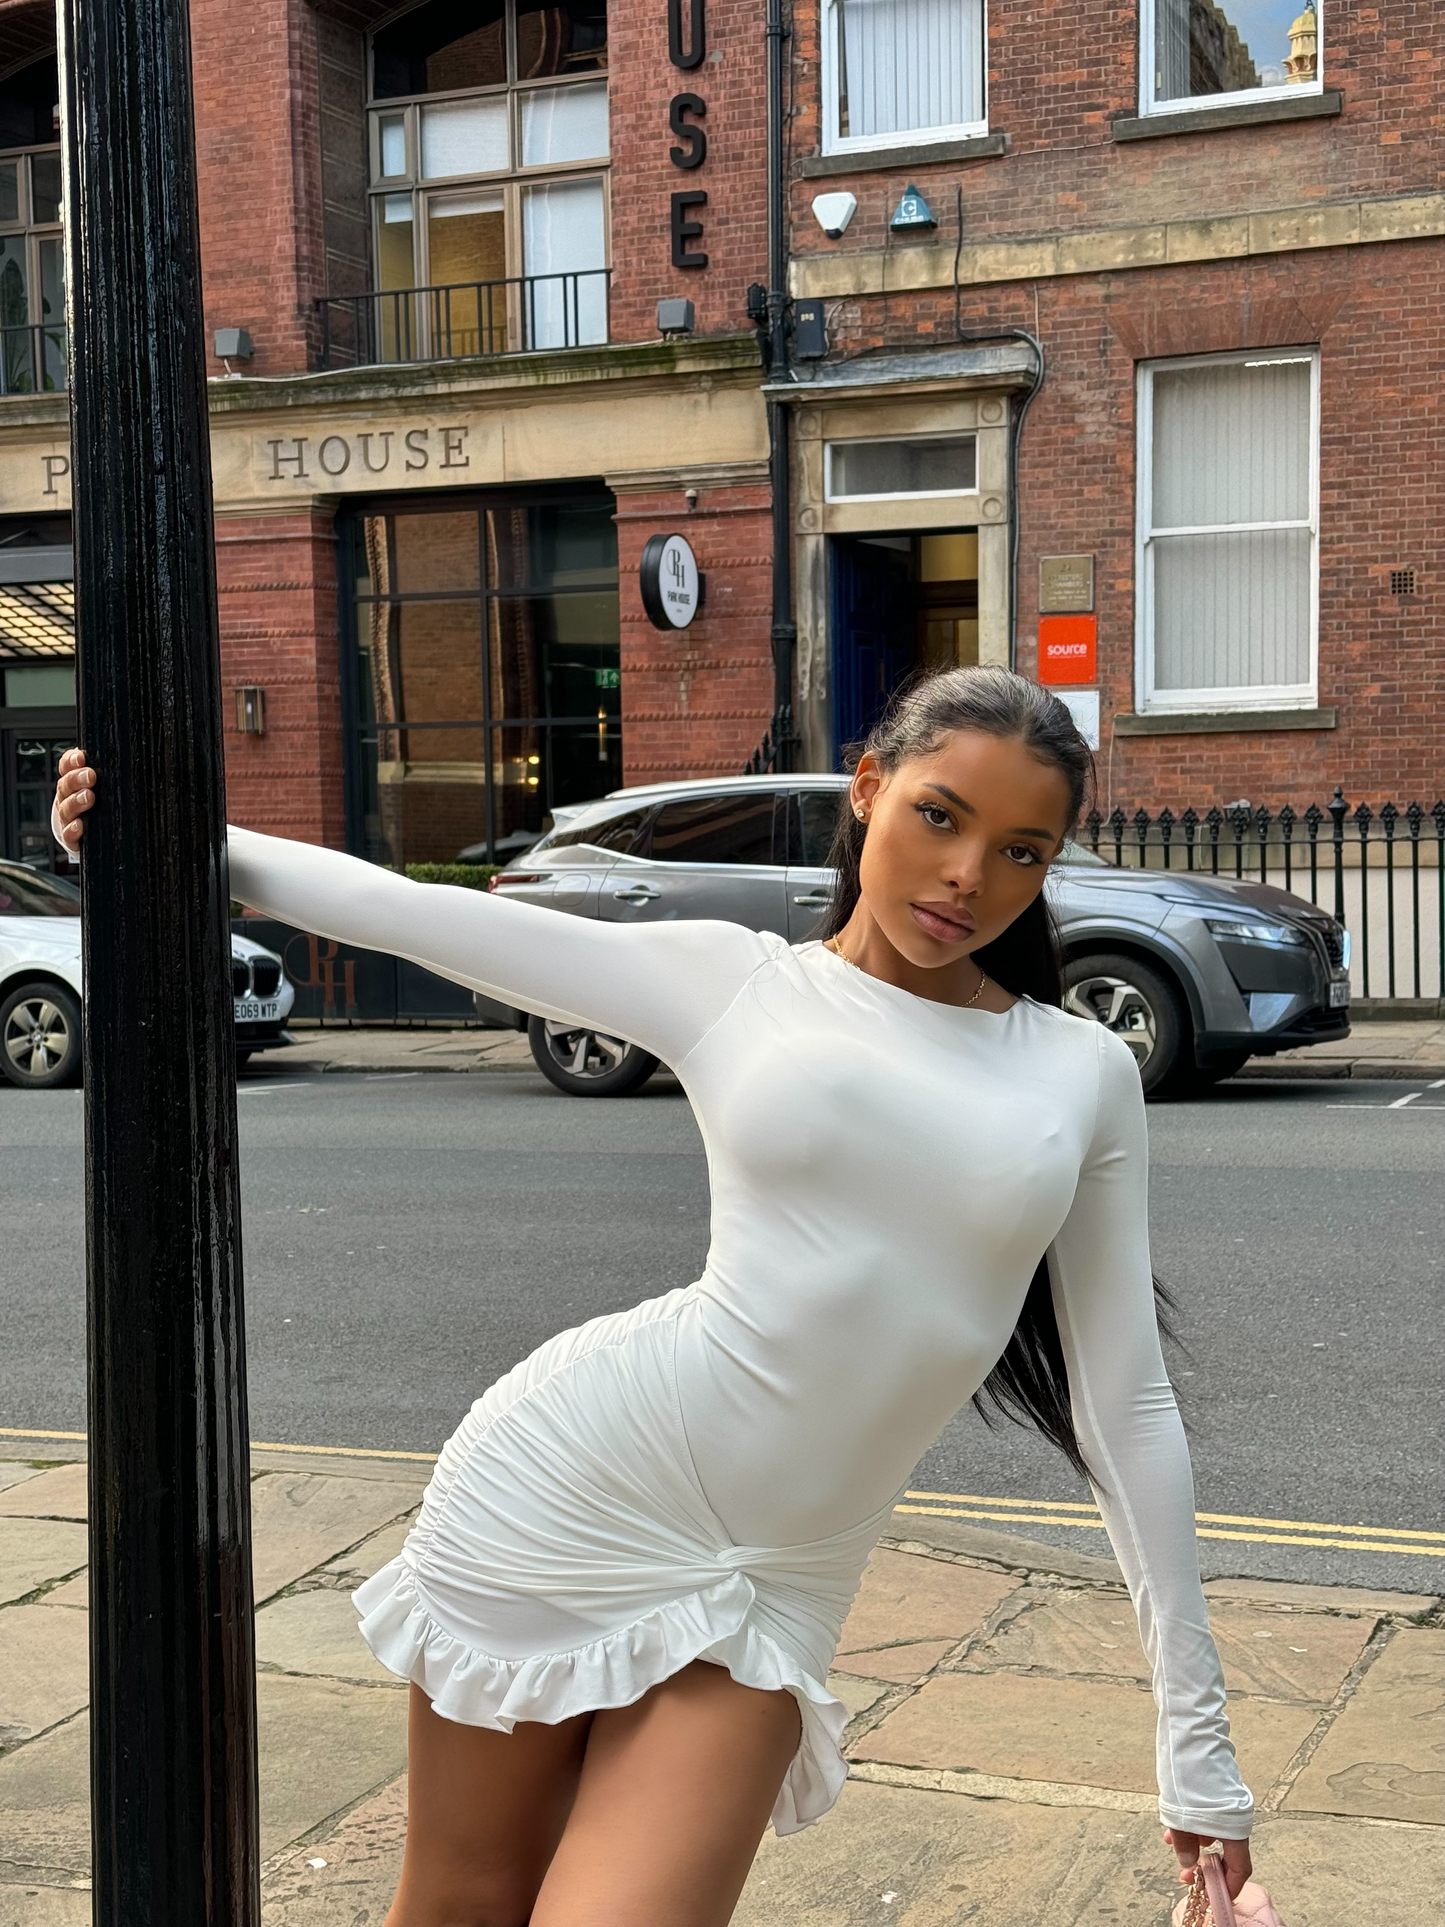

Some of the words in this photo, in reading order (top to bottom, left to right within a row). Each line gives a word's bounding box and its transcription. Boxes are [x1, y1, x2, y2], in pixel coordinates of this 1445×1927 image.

[267, 426, 470, 480] HOUSE
[1047, 643, 1087, 656] source
[260, 1003, 278, 1018] WTP
